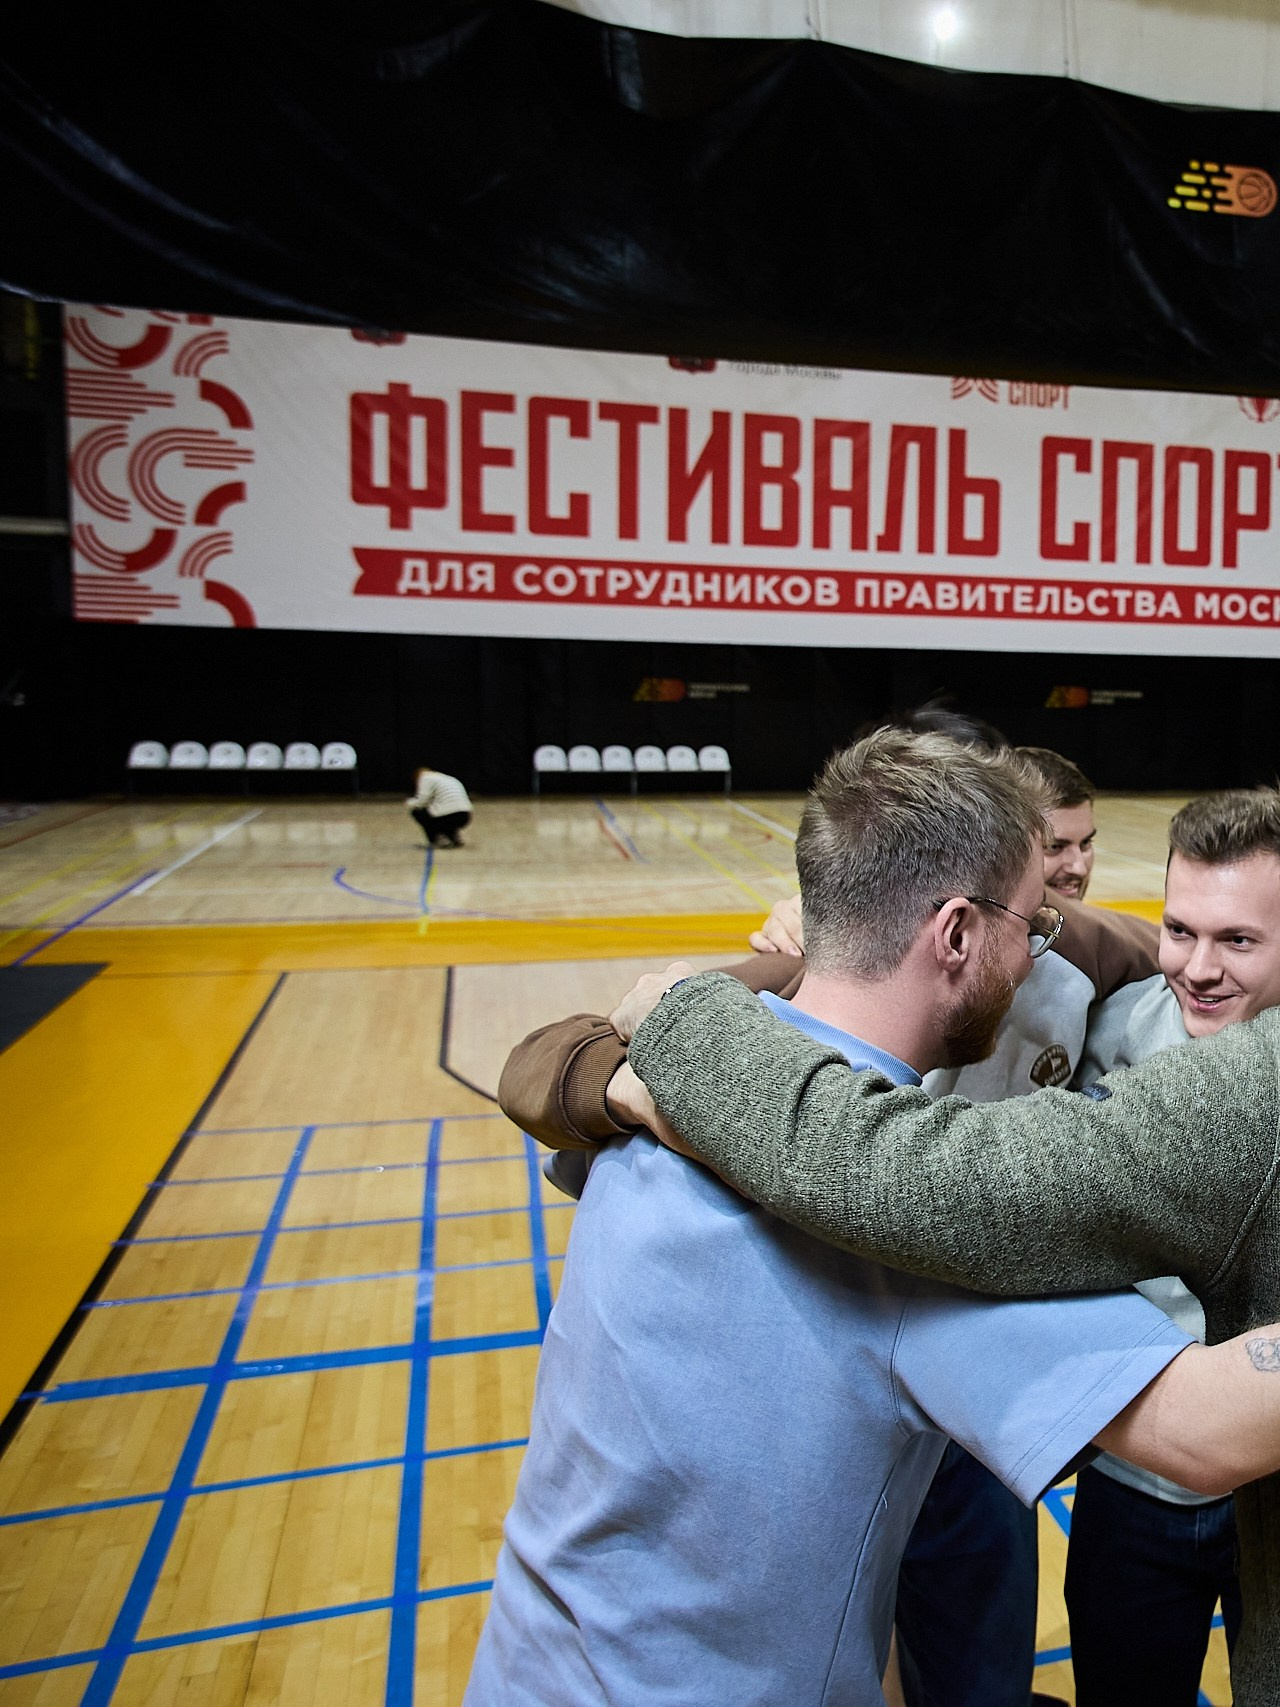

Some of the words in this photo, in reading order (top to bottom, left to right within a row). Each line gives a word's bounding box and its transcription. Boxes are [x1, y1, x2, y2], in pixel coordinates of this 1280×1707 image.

[351, 382, 1000, 557] ФЕСТИВАЛЬ
[397, 558, 496, 596] ДЛЯ
[512, 563, 841, 607] СОТРУДНИКОВ
[854, 578, 1182, 618] ПРАВИТЕЛЬСТВА
